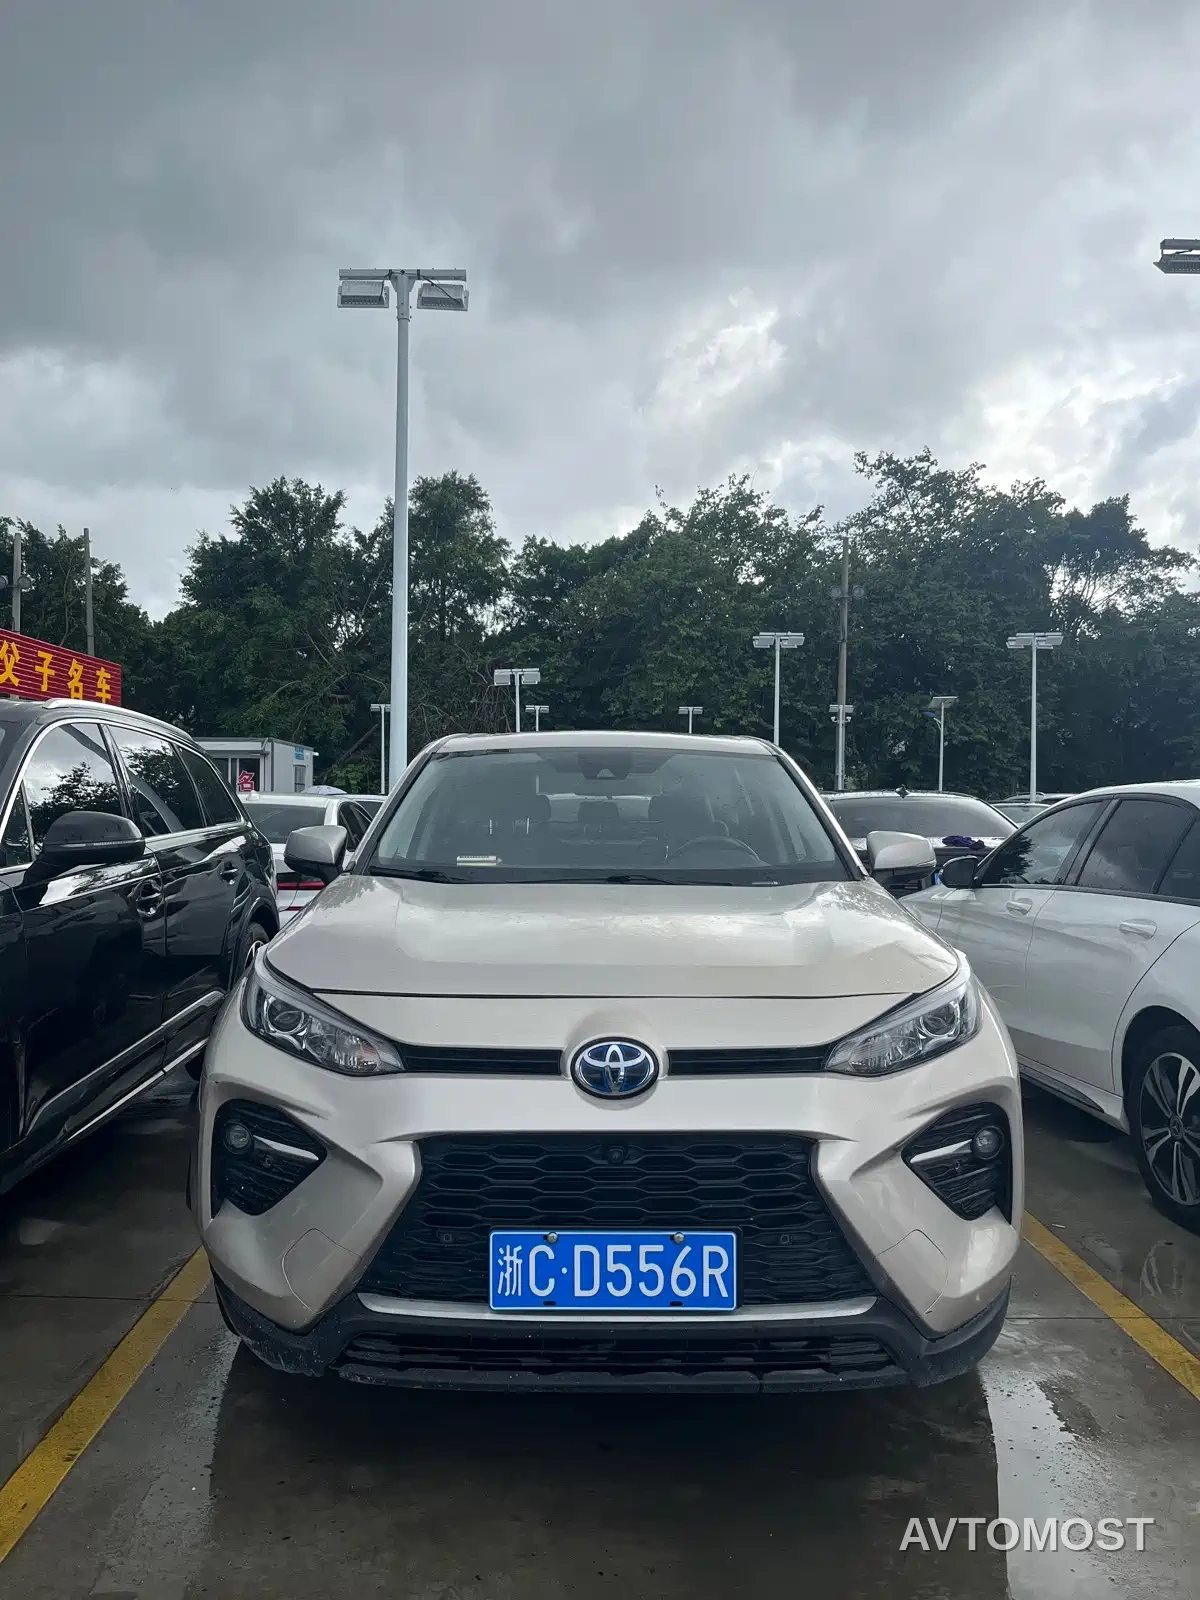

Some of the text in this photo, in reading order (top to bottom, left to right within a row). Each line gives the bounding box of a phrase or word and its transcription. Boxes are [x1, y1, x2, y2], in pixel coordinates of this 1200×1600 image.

[0, 639, 112, 703] 父子名车
[237, 770, 255, 791] 名
